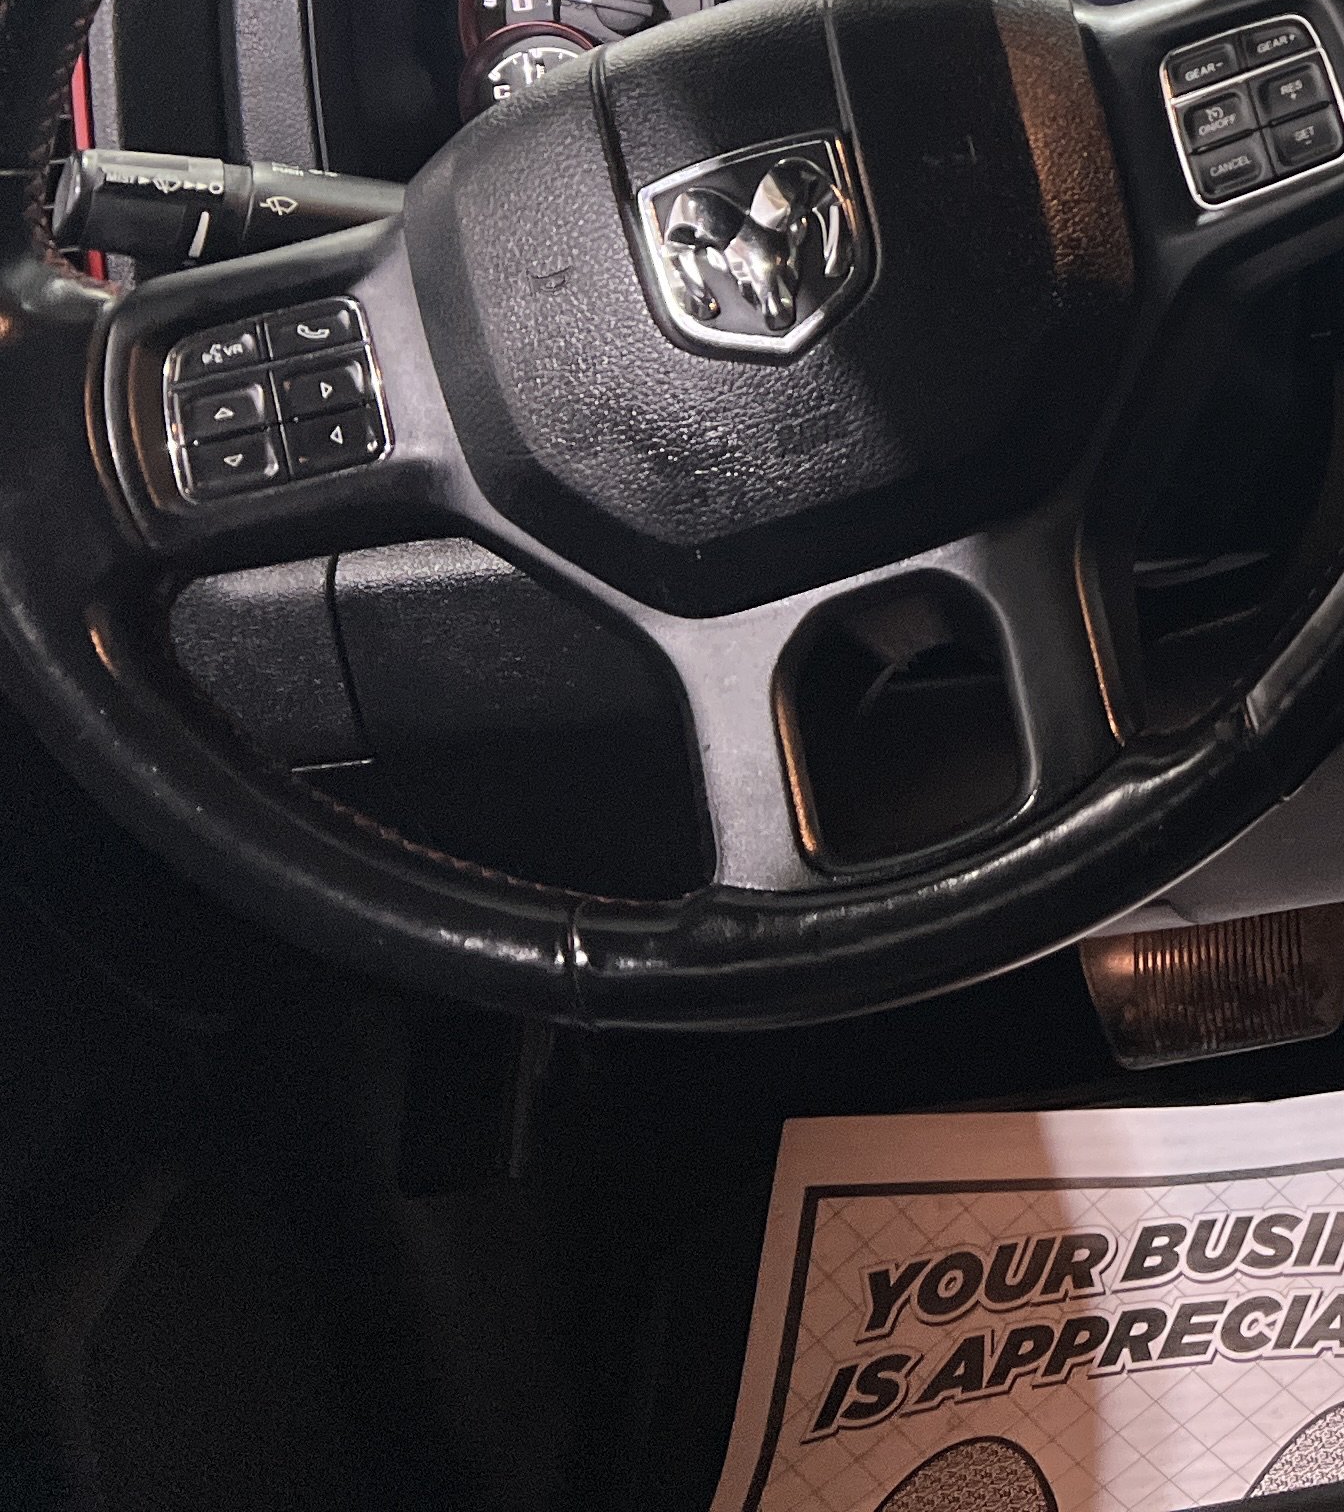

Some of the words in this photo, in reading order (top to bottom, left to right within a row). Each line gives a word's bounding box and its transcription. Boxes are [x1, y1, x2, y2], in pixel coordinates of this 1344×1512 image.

[493, 84, 511, 100] C
[1209, 155, 1251, 177] CANCEL
[862, 1232, 1112, 1333] YOUR
[811, 1359, 915, 1434] IS
